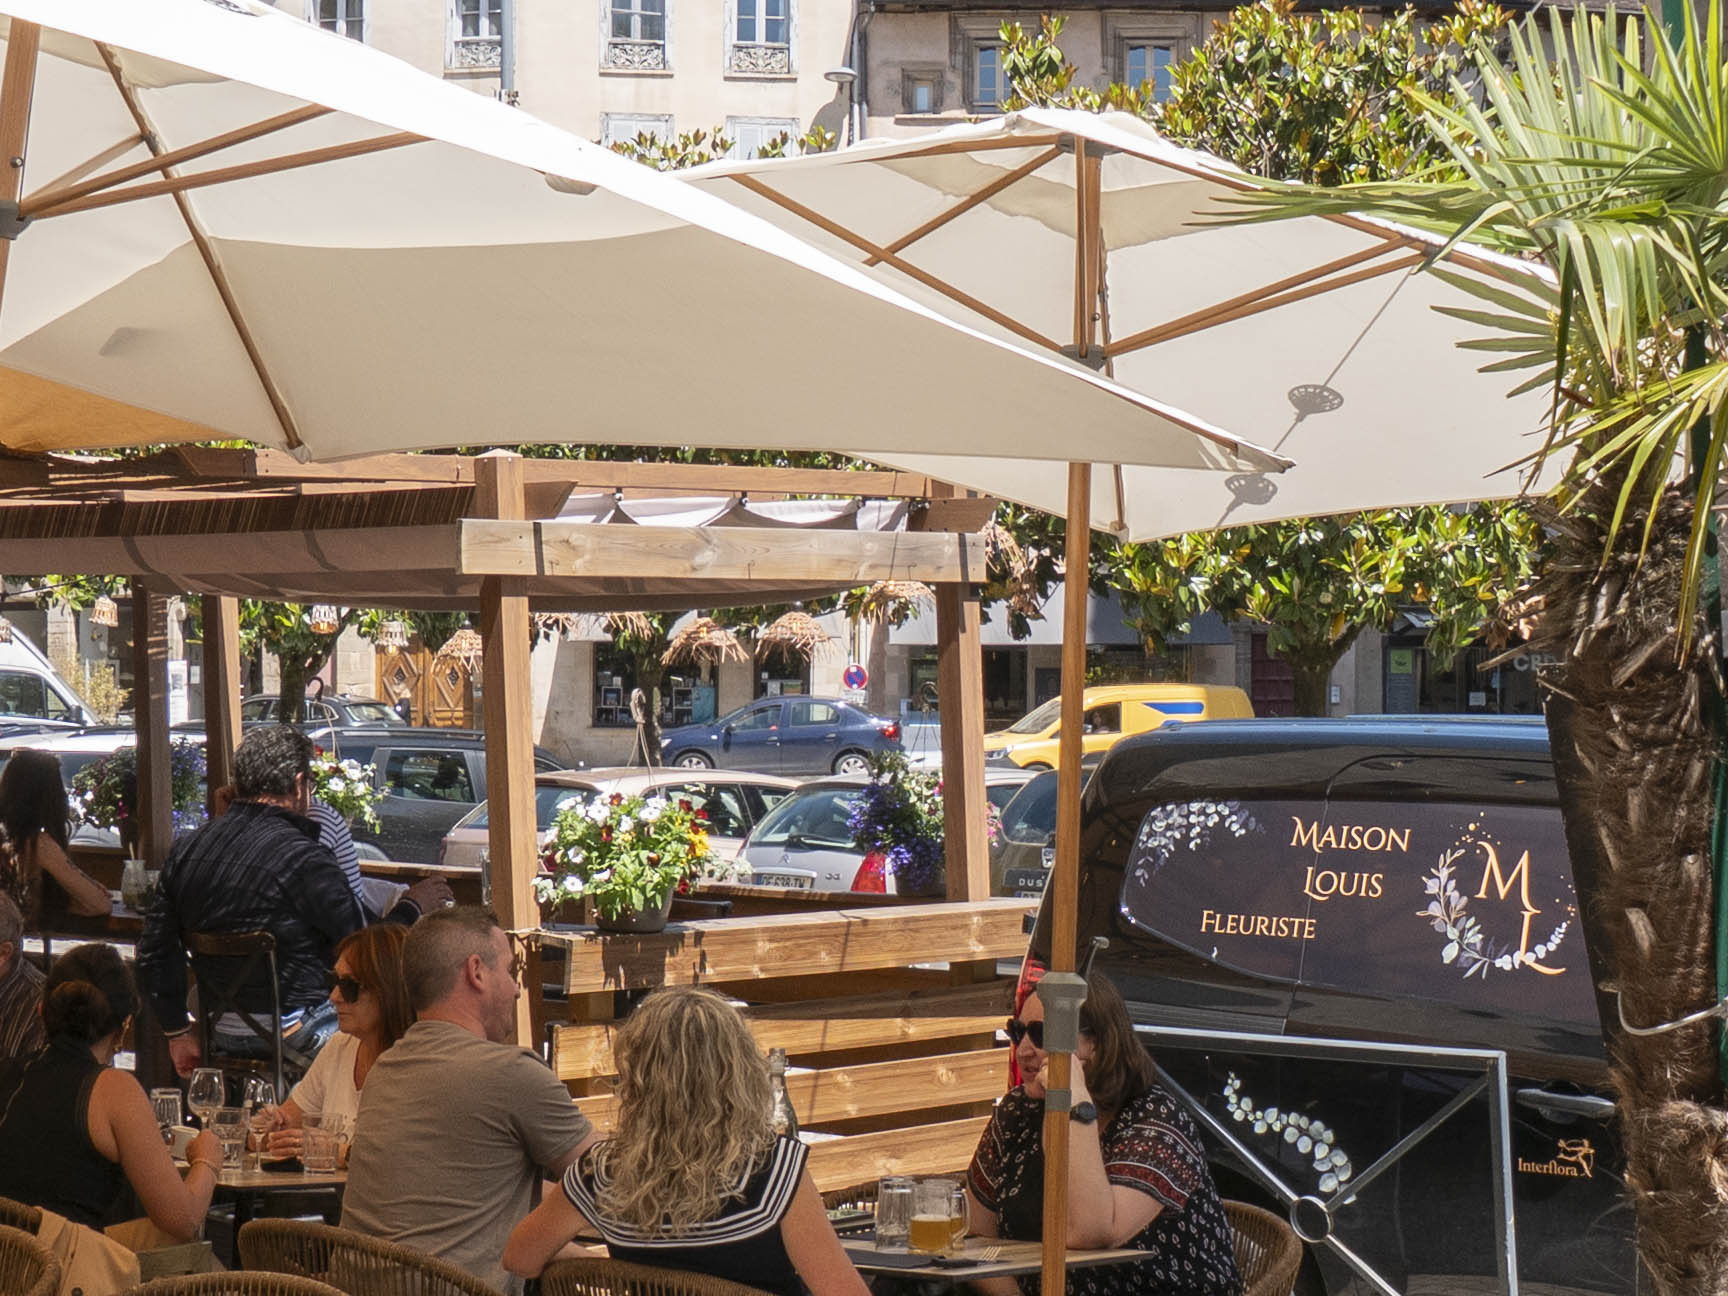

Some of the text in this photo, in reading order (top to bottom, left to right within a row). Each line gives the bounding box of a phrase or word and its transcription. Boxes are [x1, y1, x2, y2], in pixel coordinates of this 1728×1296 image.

[1290, 816, 1411, 854] MAISON
[1303, 867, 1384, 901] LOUIS
[1200, 909, 1317, 939] FLEURISTE
[1517, 1157, 1578, 1177] Interflora
